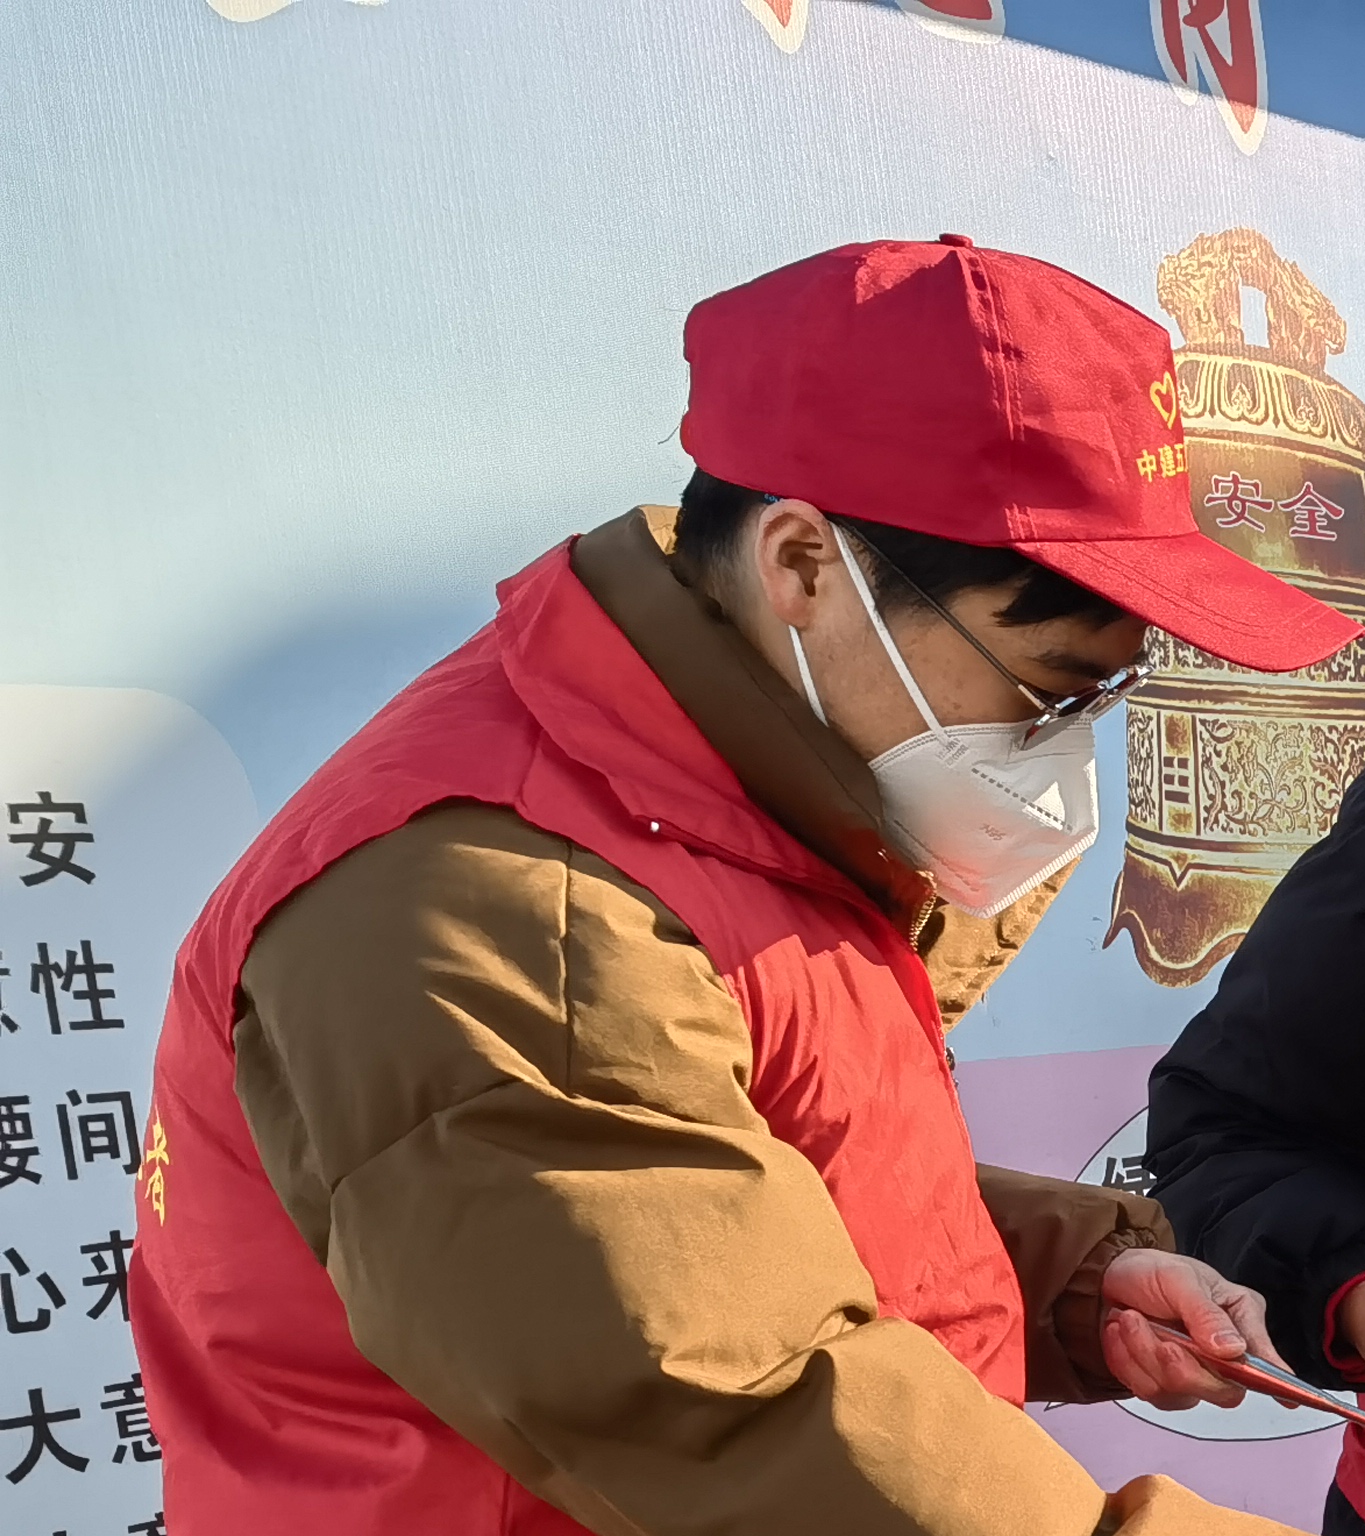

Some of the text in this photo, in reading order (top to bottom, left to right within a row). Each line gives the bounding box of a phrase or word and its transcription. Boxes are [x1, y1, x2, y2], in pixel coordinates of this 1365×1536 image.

[1136, 443, 1188, 482] 中建五
[1204, 471, 1344, 541] 安全
[0, 940, 125, 1035] 性
[137, 1103, 170, 1227] 者
